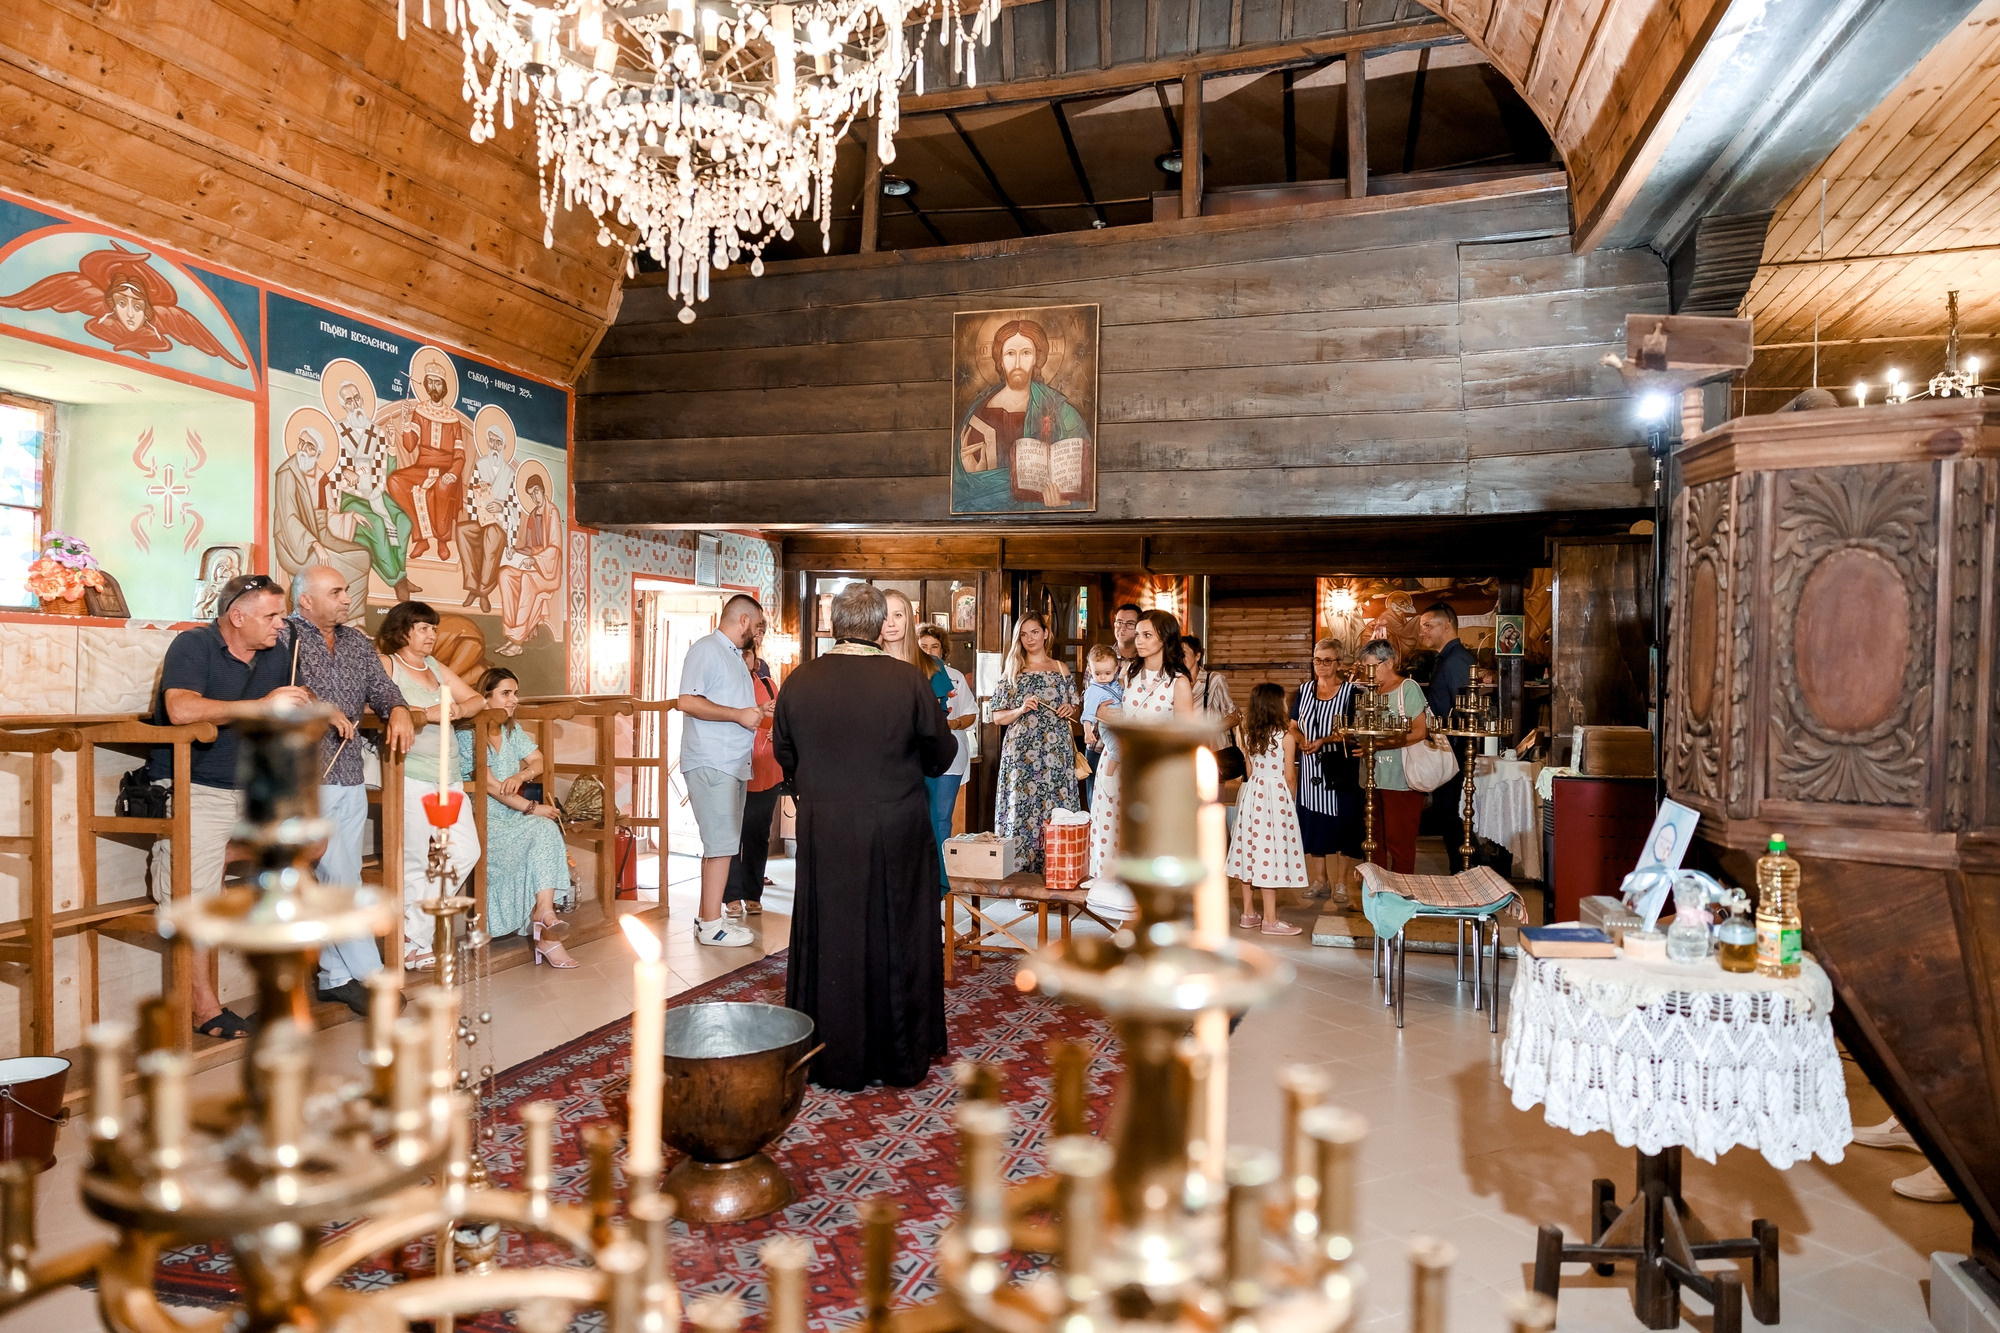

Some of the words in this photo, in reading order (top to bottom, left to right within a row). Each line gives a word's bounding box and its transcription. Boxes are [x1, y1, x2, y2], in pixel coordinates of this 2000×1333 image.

[350, 330, 399, 355] ВСЕЛЕНСКИ
[467, 370, 489, 389] СЪБОР
[494, 379, 516, 394] НИКЕЯ
